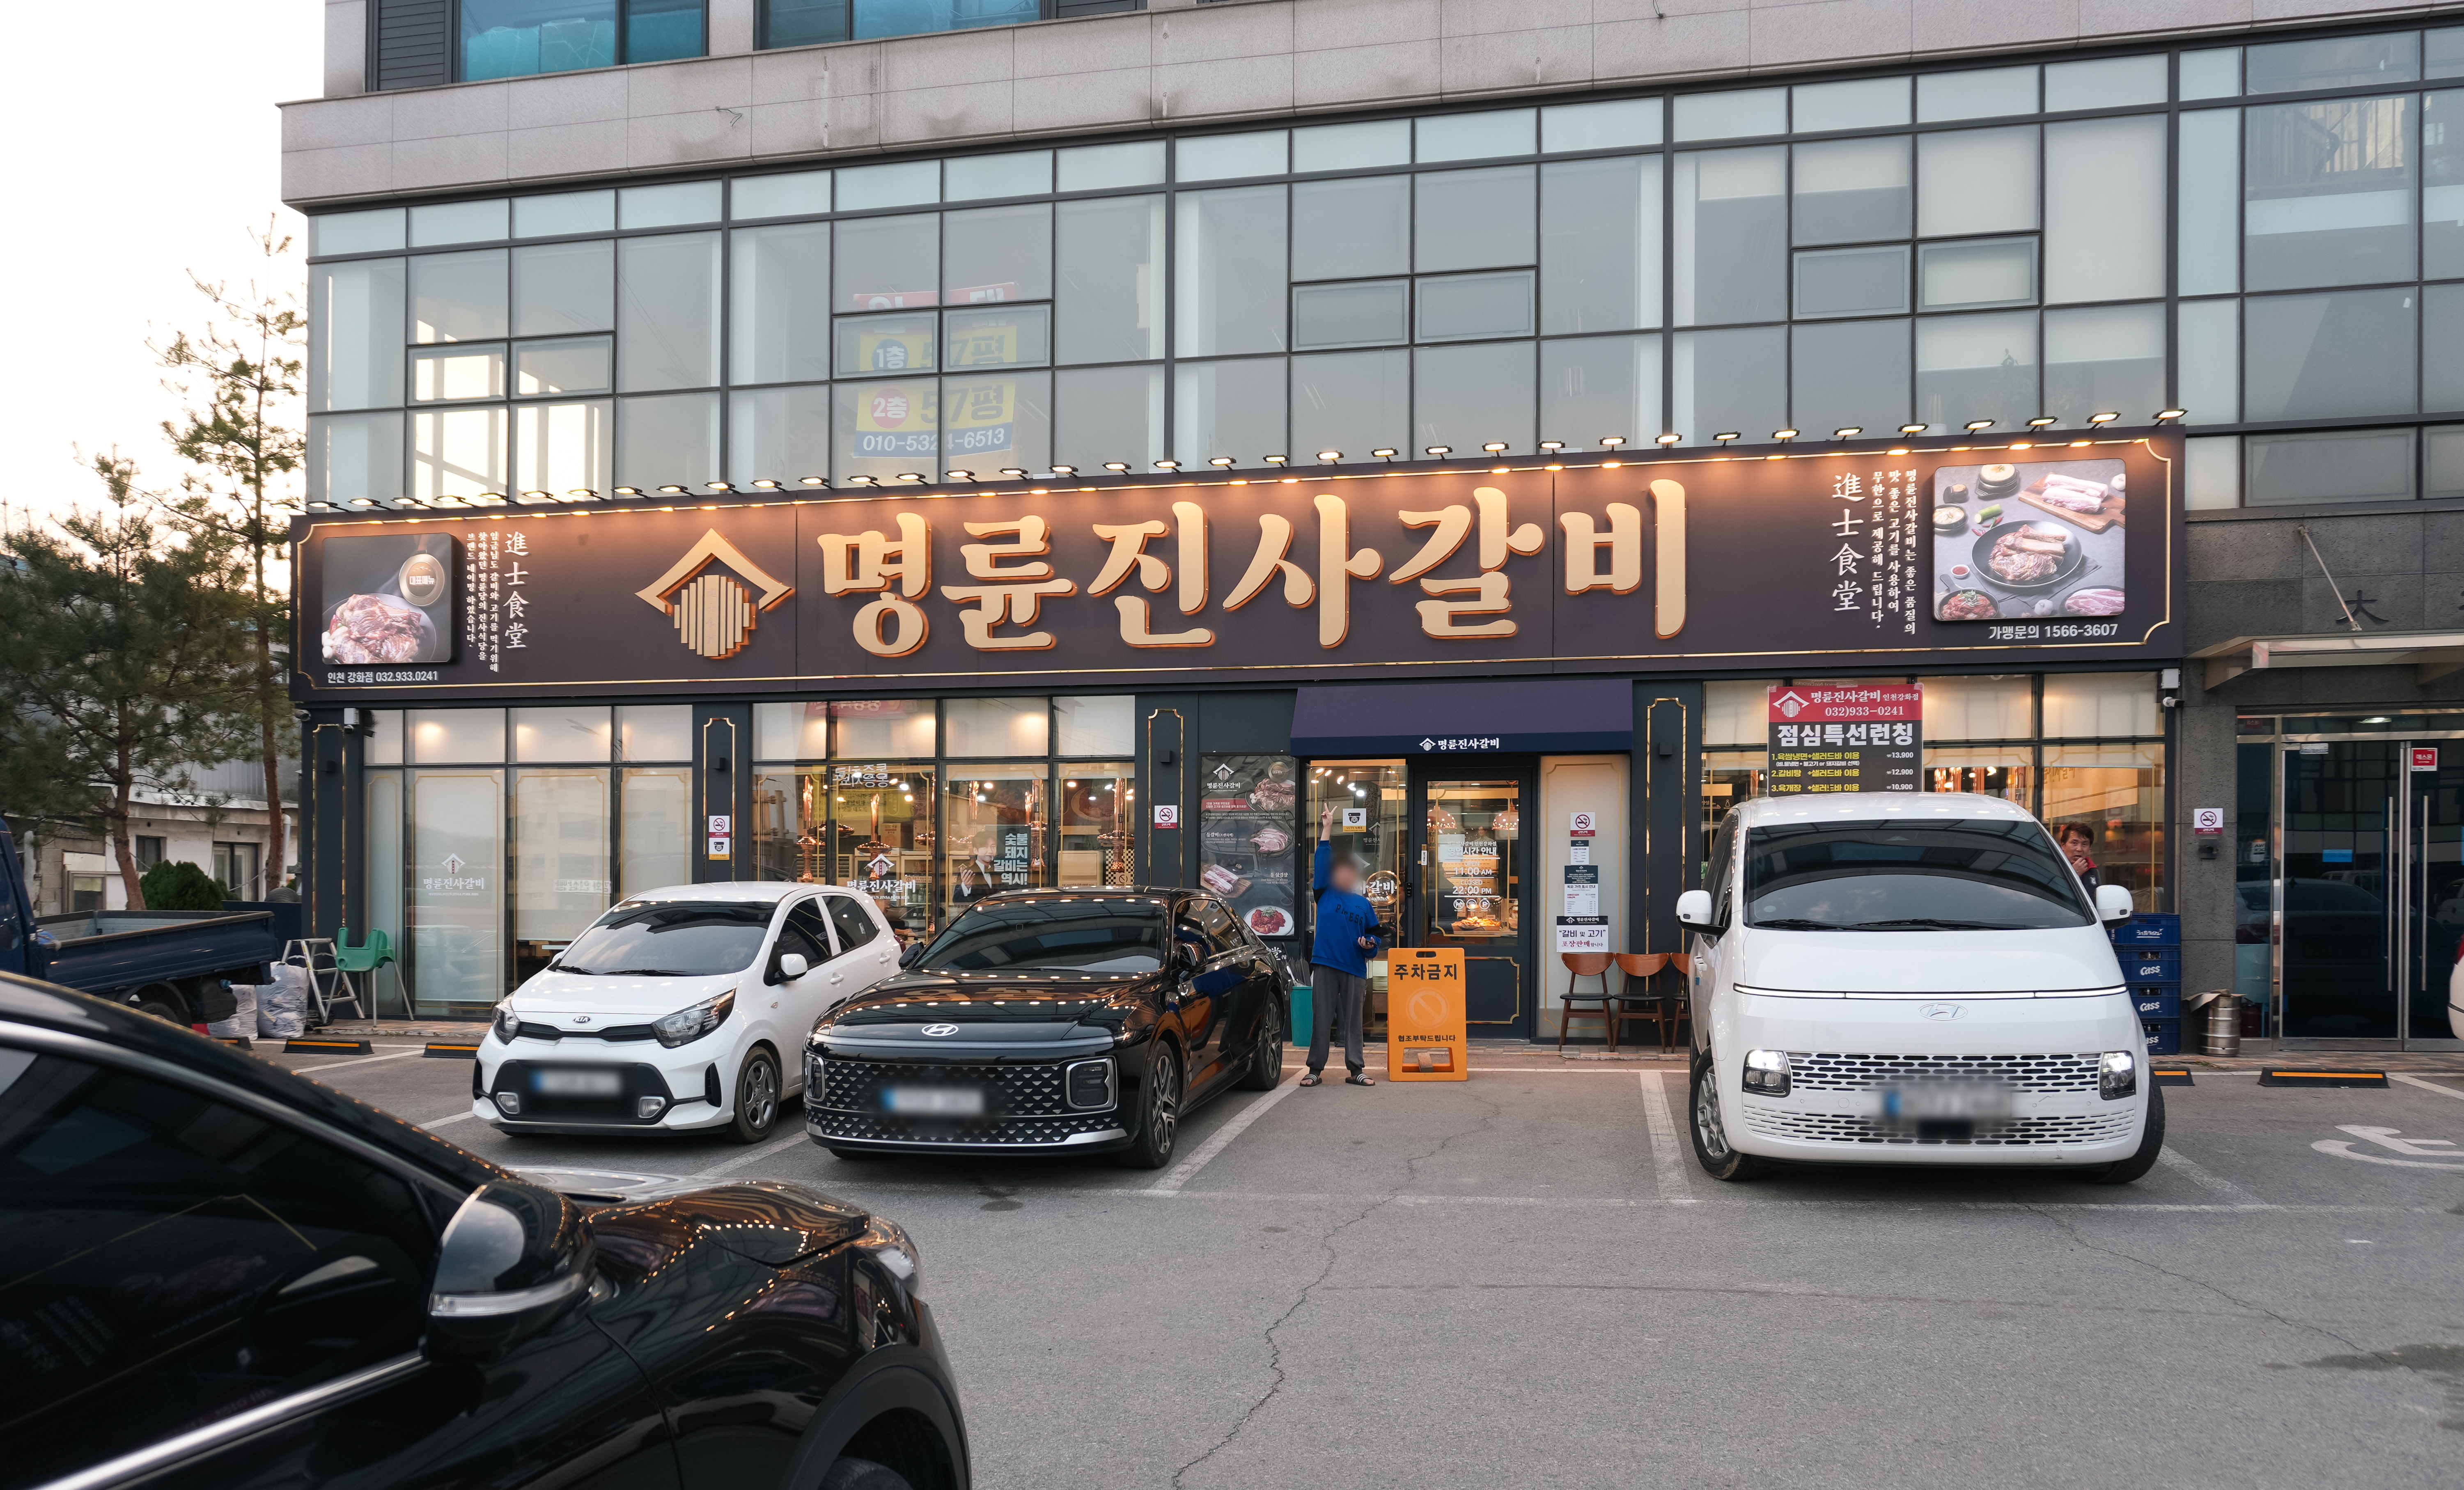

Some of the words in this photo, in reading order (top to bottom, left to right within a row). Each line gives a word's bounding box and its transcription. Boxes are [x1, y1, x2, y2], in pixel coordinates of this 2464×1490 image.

[876, 346, 905, 369] 1층
[873, 397, 907, 418] 2층
[1889, 470, 1902, 483] 맛
[1872, 471, 1885, 521] 무한으로
[1888, 487, 1901, 512] 좋은
[1904, 469, 1918, 561] 명륜진사갈비는
[1830, 472, 1865, 611] 進士食堂
[1871, 527, 1884, 566] 제공해
[1888, 518, 1901, 555] 고기를
[478, 532, 488, 570] 찾아왔던
[489, 531, 499, 568] 임금님도
[466, 564, 476, 592] 네이밍
[817, 479, 1688, 658] 명륜진사갈비
[1904, 566, 1917, 591] 좋은
[409, 575, 435, 585] 대표메뉴
[489, 572, 499, 601] 갈비와
[503, 531, 530, 649] 進士食堂
[1887, 560, 1901, 612] 사용하여
[478, 573, 487, 610] 명륜당의
[1871, 571, 1884, 628] 드립니다.
[489, 604, 498, 631] 고기를
[1904, 596, 1916, 635] 품질의
[477, 613, 487, 660] 진사식당을
[1989, 625, 2039, 639] 가맹문의
[2044, 624, 2118, 638] 1566-3607
[489, 635, 498, 672] 먹기위해
[328, 672, 345, 683] 인천
[347, 671, 374, 683] 강화점
[376, 670, 438, 682] 032.933.0241
[1811, 690, 1881, 703] 명륜진사갈비
[1825, 706, 1904, 717] 032)933-0241
[1438, 738, 1499, 750] 명륜진사갈비
[1778, 723, 1913, 747] 점심특선런칭
[1845, 752, 1860, 760] 이용
[1845, 768, 1860, 777] 이용
[1005, 833, 1028, 845] 숯불
[1005, 846, 1028, 858] 돼지
[1448, 847, 1479, 856] 영업시간
[1481, 847, 1497, 855] 안내
[994, 860, 1028, 871] 갈비는
[1454, 867, 1479, 875] 11:00
[423, 877, 485, 890] 명륜진사갈비
[847, 879, 916, 893] 명륜진사갈비
[1001, 873, 1028, 885] 역시!
[1452, 886, 1479, 895] 22:00
[1394, 963, 1457, 980] 주차금지
[2140, 965, 2160, 976] Cass
[2140, 1002, 2160, 1011] Cass
[2146, 1036, 2159, 1045] ass
